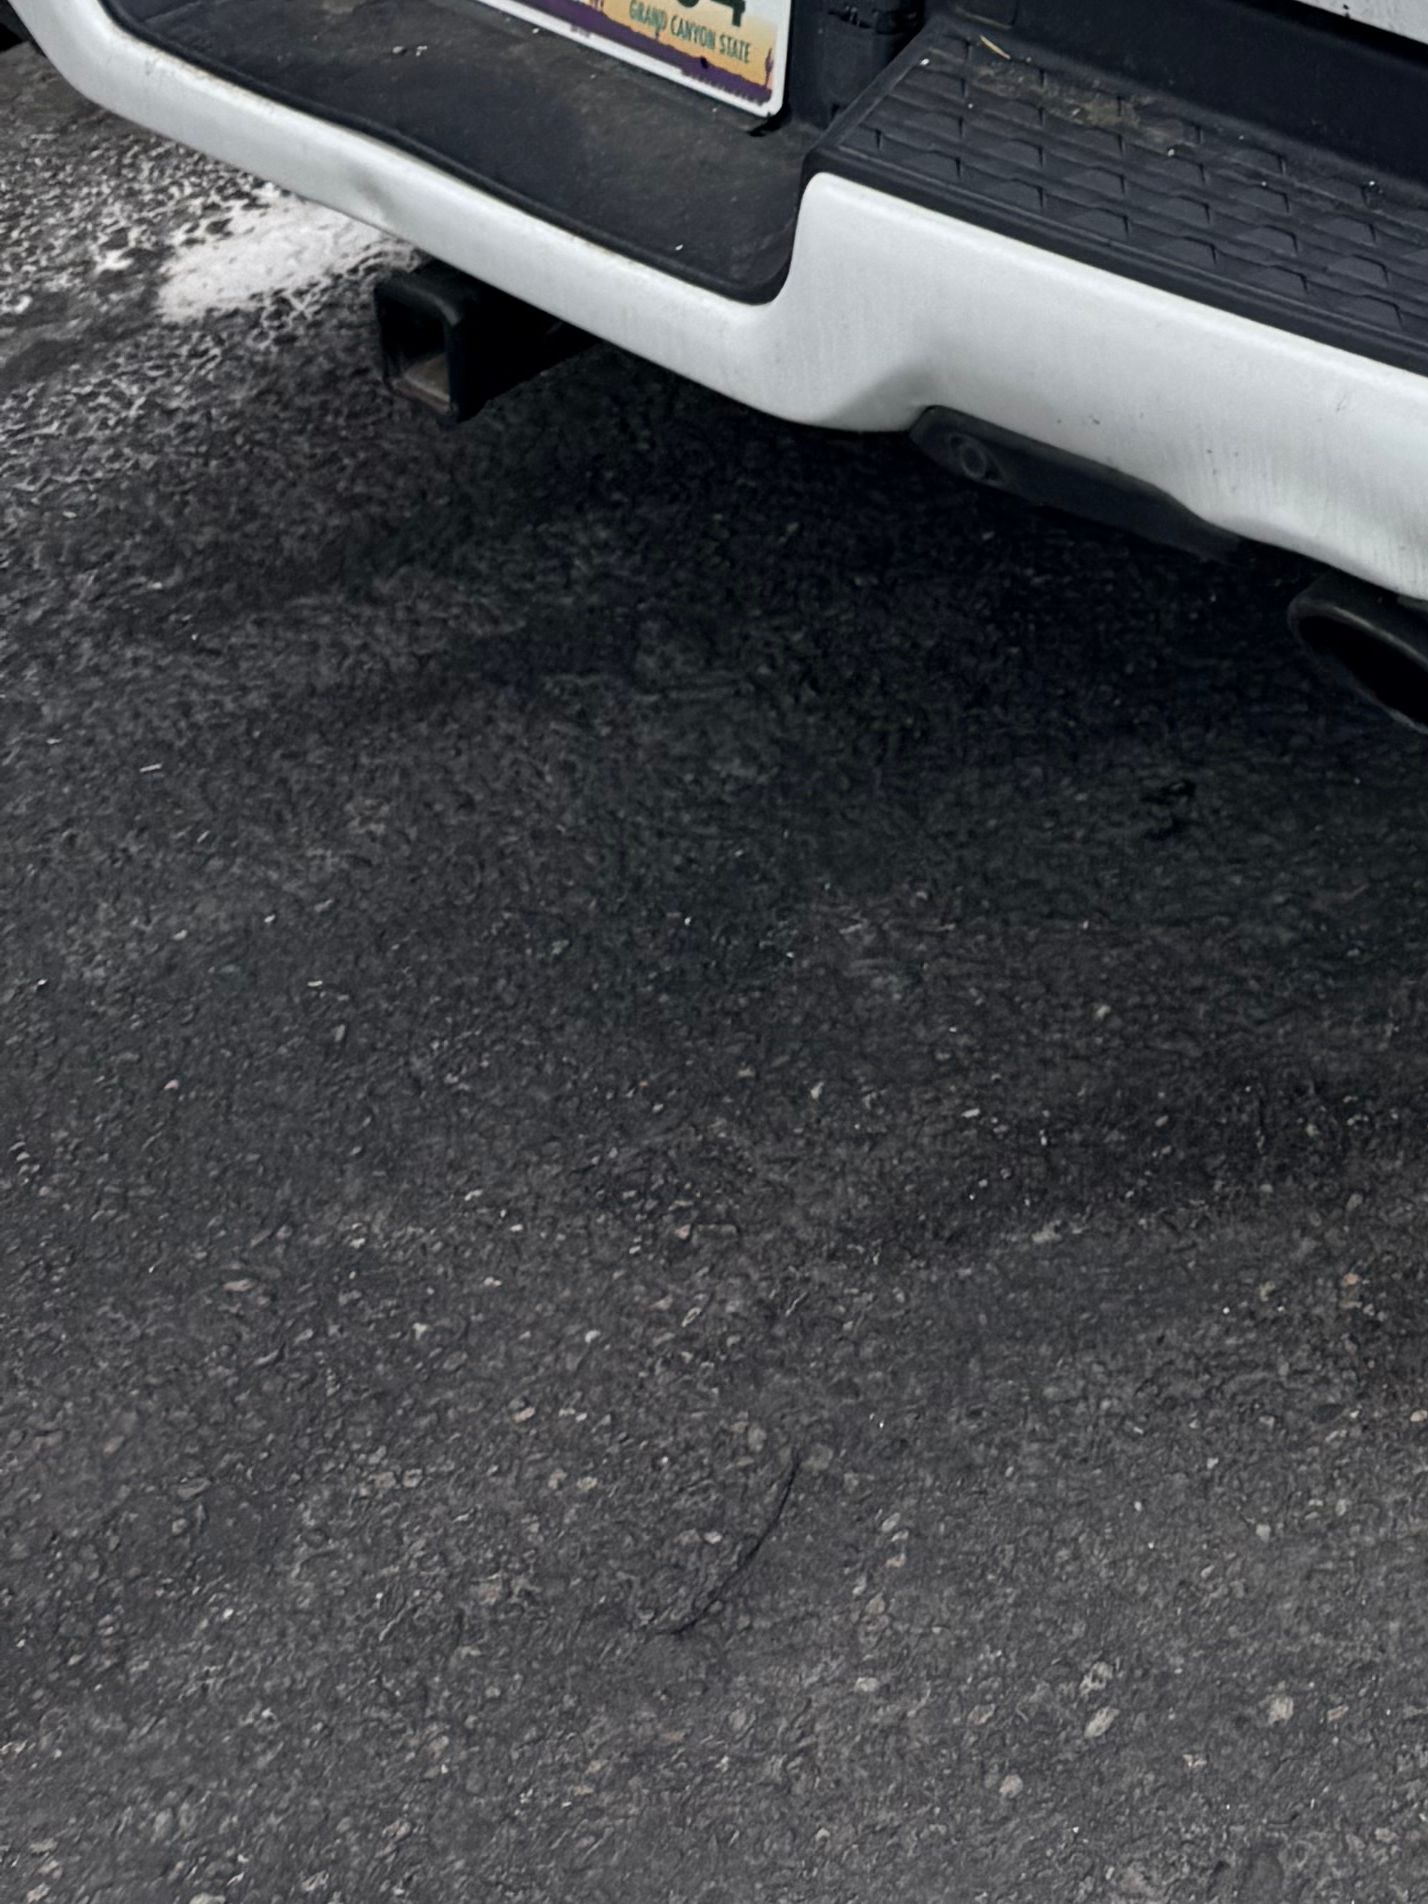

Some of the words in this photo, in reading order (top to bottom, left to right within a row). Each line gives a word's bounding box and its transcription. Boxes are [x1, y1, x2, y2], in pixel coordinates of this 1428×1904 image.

[629, 0, 667, 34] GRAND
[670, 14, 717, 54] CANYON
[719, 33, 750, 64] STATE
